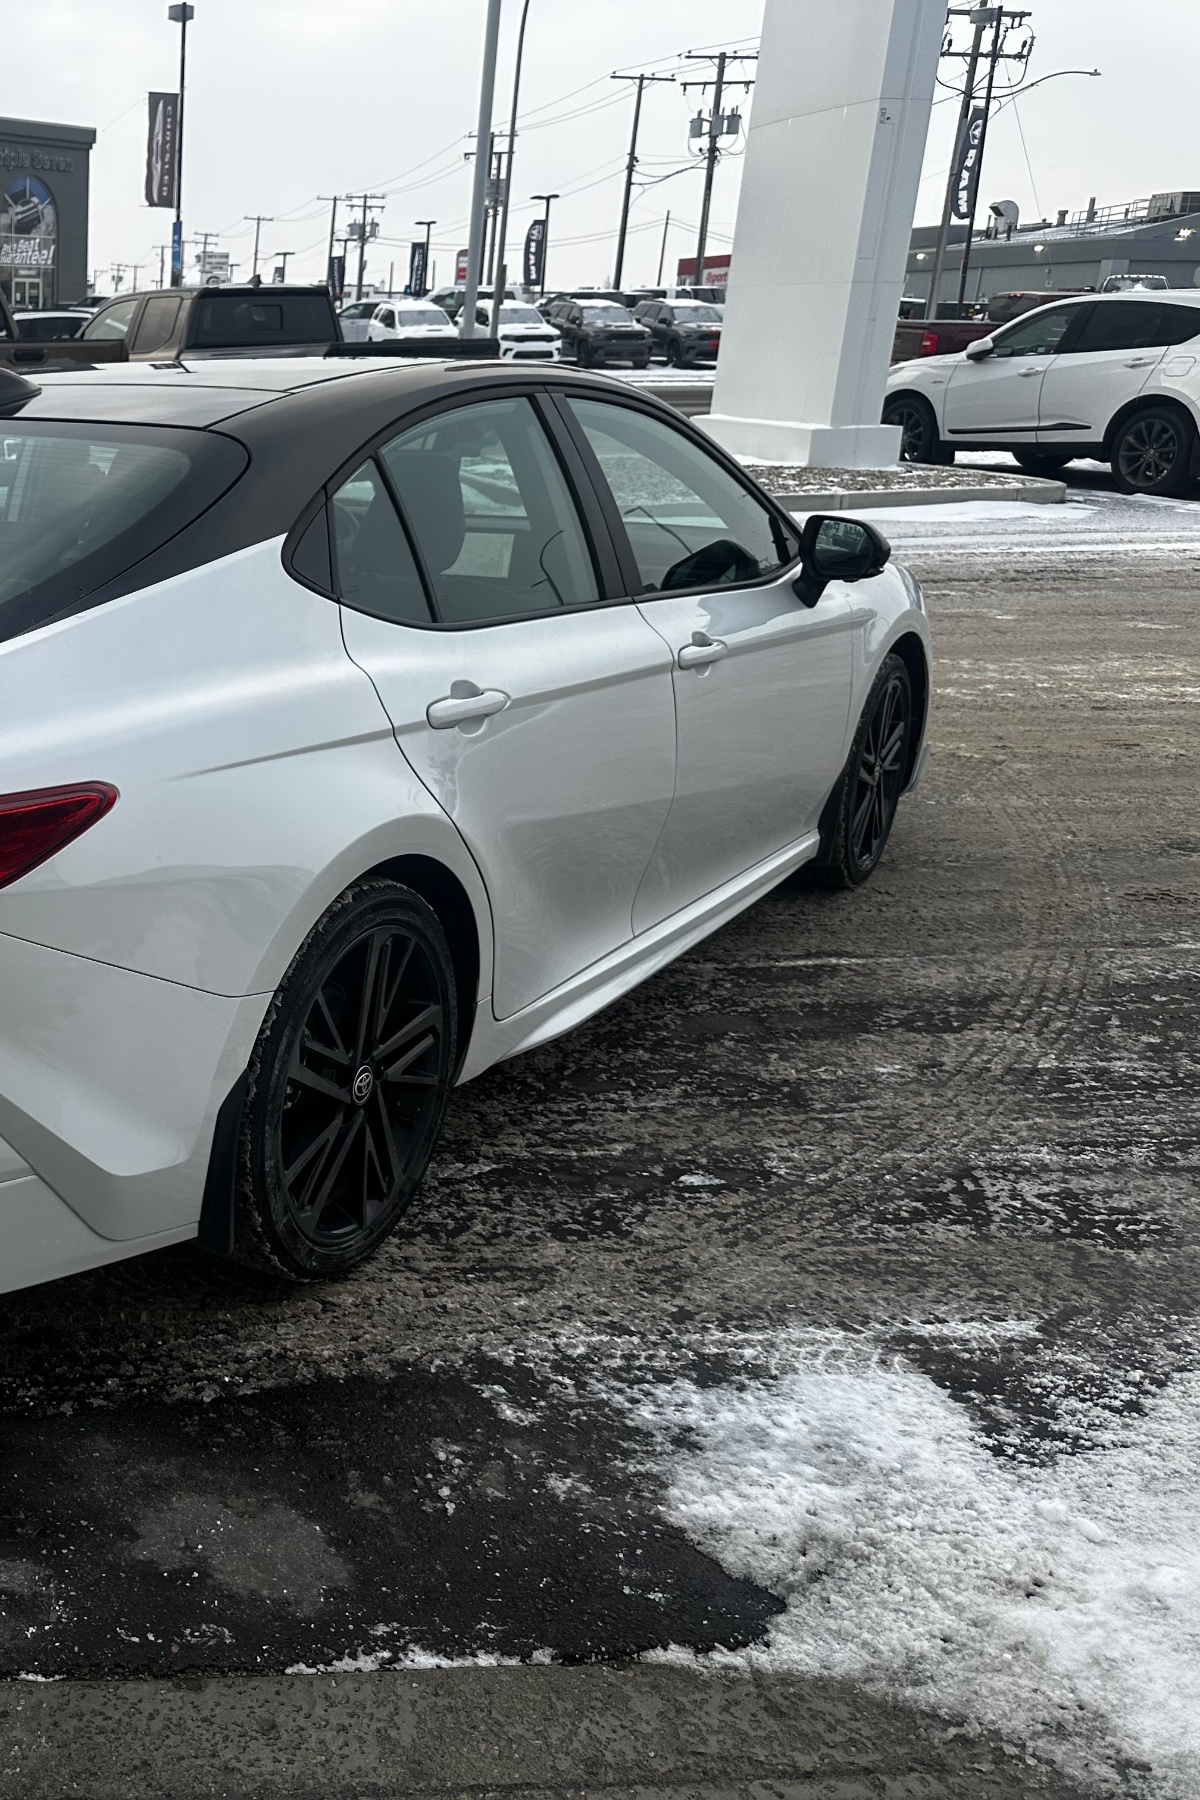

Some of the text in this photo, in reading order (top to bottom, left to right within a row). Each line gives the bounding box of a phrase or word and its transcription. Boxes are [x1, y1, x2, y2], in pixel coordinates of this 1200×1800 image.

[32, 150, 74, 172] Seven
[958, 149, 977, 213] RAM
[529, 241, 537, 280] RAM
